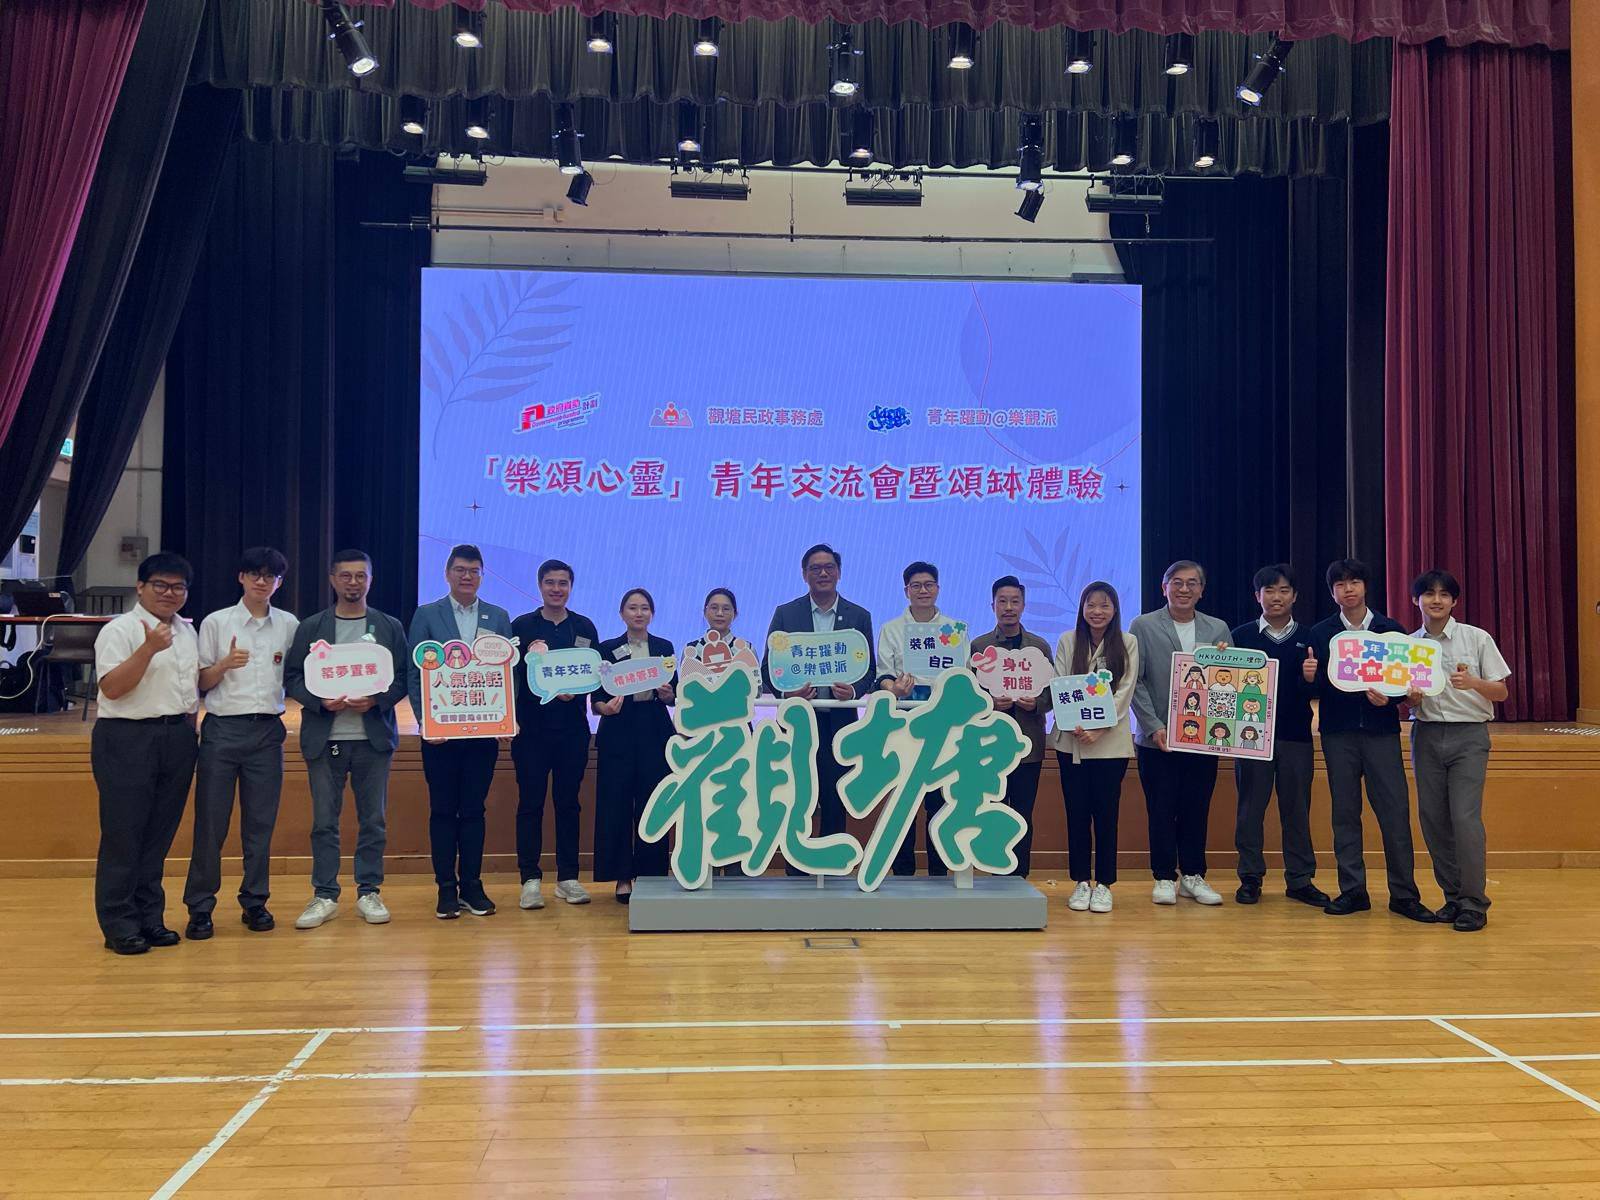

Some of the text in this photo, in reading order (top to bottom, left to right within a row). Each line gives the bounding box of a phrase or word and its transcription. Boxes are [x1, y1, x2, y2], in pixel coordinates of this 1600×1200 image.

[708, 407, 825, 427] 觀塘民政事務處
[927, 407, 1058, 427] 青年躍動@樂觀派
[487, 457, 1104, 500] 「樂頌心靈」 青年交流會暨頌缽體驗
[790, 641, 848, 659] 青年躍動
[909, 637, 936, 650] 裝備
[790, 660, 848, 677] @樂觀派
[929, 655, 954, 669] 自己
[1002, 657, 1033, 672] 身心
[541, 663, 593, 679] 青年交流
[431, 671, 504, 689] 人氣熱話
[1002, 675, 1033, 691] 和諧
[450, 689, 488, 707] 資訊
[1058, 688, 1085, 705] 裝備
[1080, 707, 1106, 720] 自己
[643, 668, 1029, 889] 觀塘
